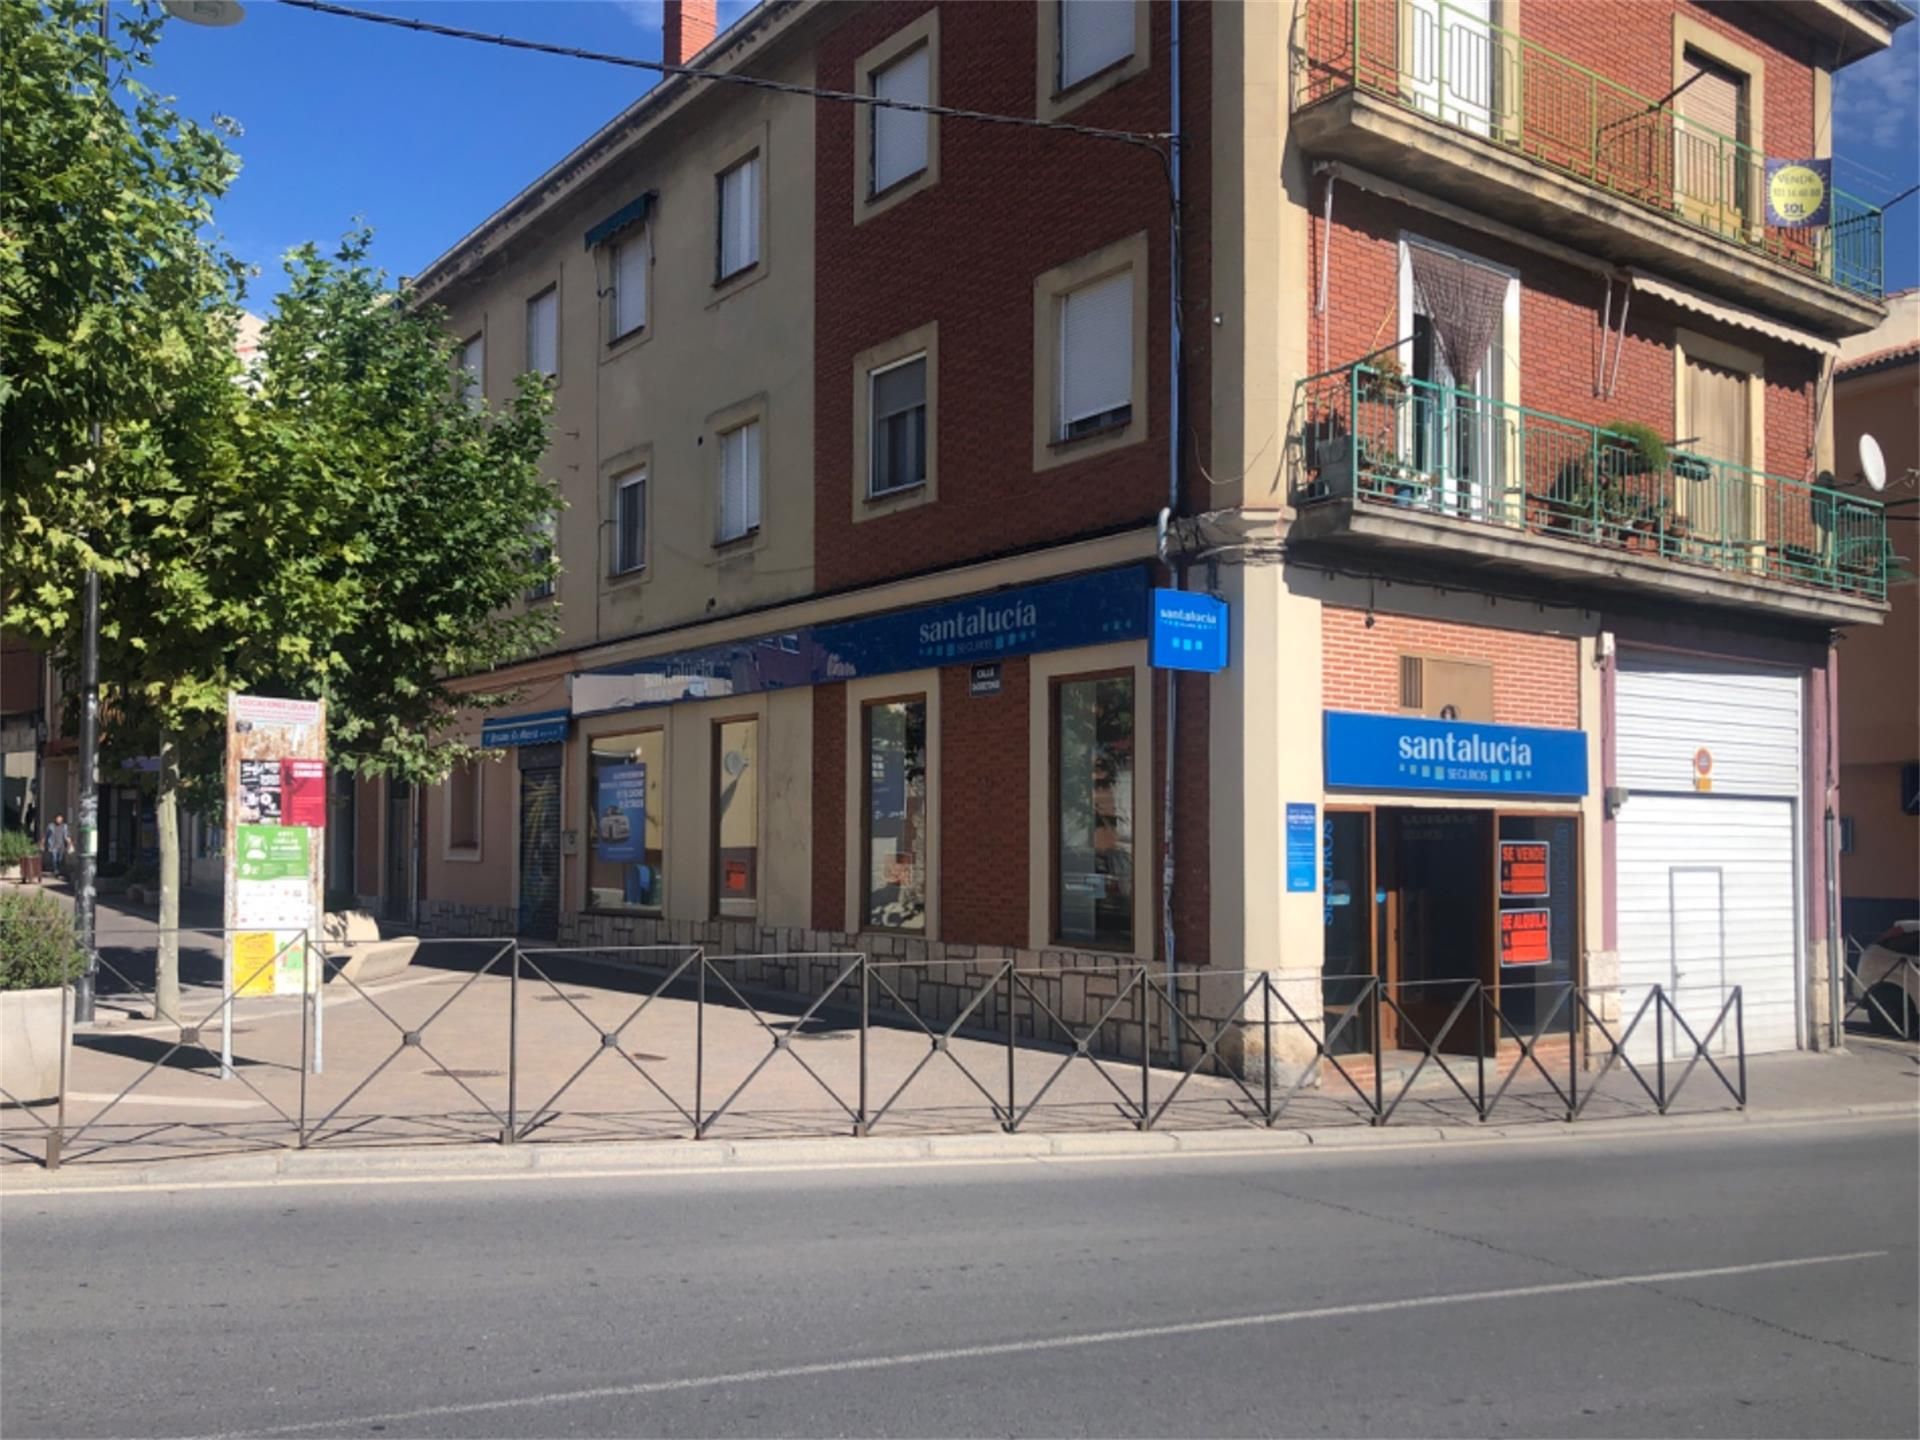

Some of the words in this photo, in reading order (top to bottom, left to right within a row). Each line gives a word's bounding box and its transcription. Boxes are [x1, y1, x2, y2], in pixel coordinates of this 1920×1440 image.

[1783, 203, 1806, 214] SOL
[919, 599, 1037, 644] santalucía
[1398, 732, 1532, 766] santalucía
[1447, 767, 1488, 782] SEGUROS
[1502, 846, 1514, 862] SE
[1516, 846, 1546, 862] VENDE
[1502, 914, 1513, 930] SE
[1513, 912, 1548, 930] ALQUILA
